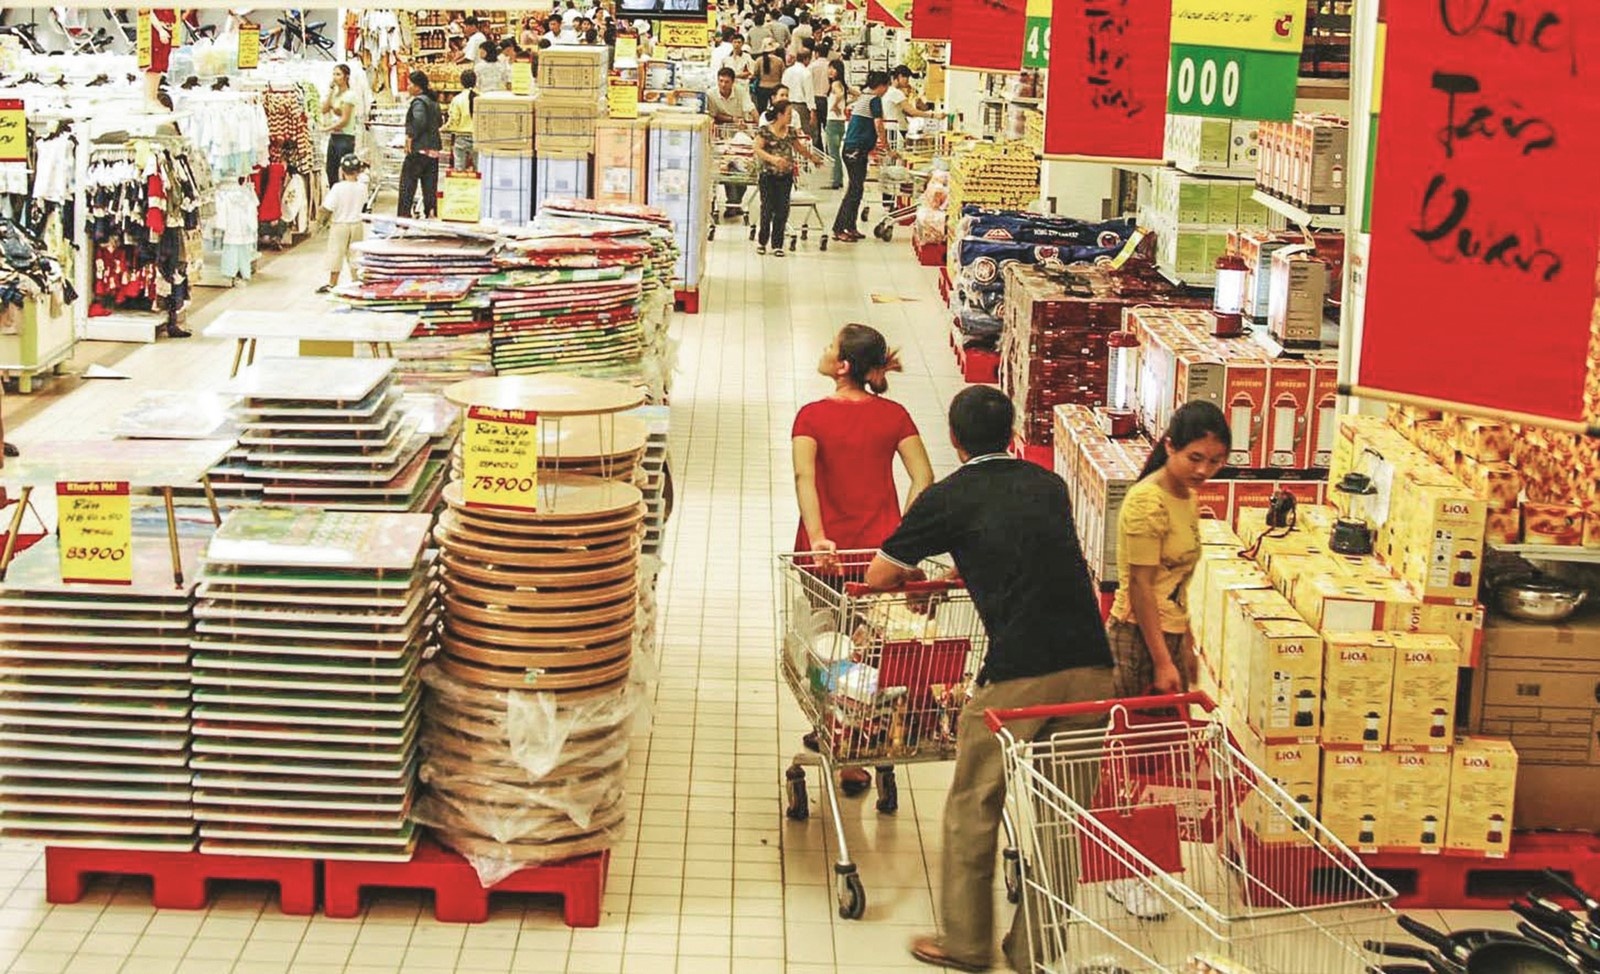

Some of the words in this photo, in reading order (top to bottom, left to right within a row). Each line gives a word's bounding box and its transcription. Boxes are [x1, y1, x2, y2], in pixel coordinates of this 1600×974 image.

[1177, 57, 1240, 107] 000
[1442, 503, 1470, 515] LiOA
[1277, 644, 1304, 654] LiOA
[1340, 651, 1368, 662] LiOA
[1404, 653, 1433, 663] LiOA
[1275, 751, 1302, 761] LiOA
[1335, 755, 1363, 766] LiOA
[1398, 756, 1425, 766] LiOA
[1463, 757, 1491, 768] LiOA
